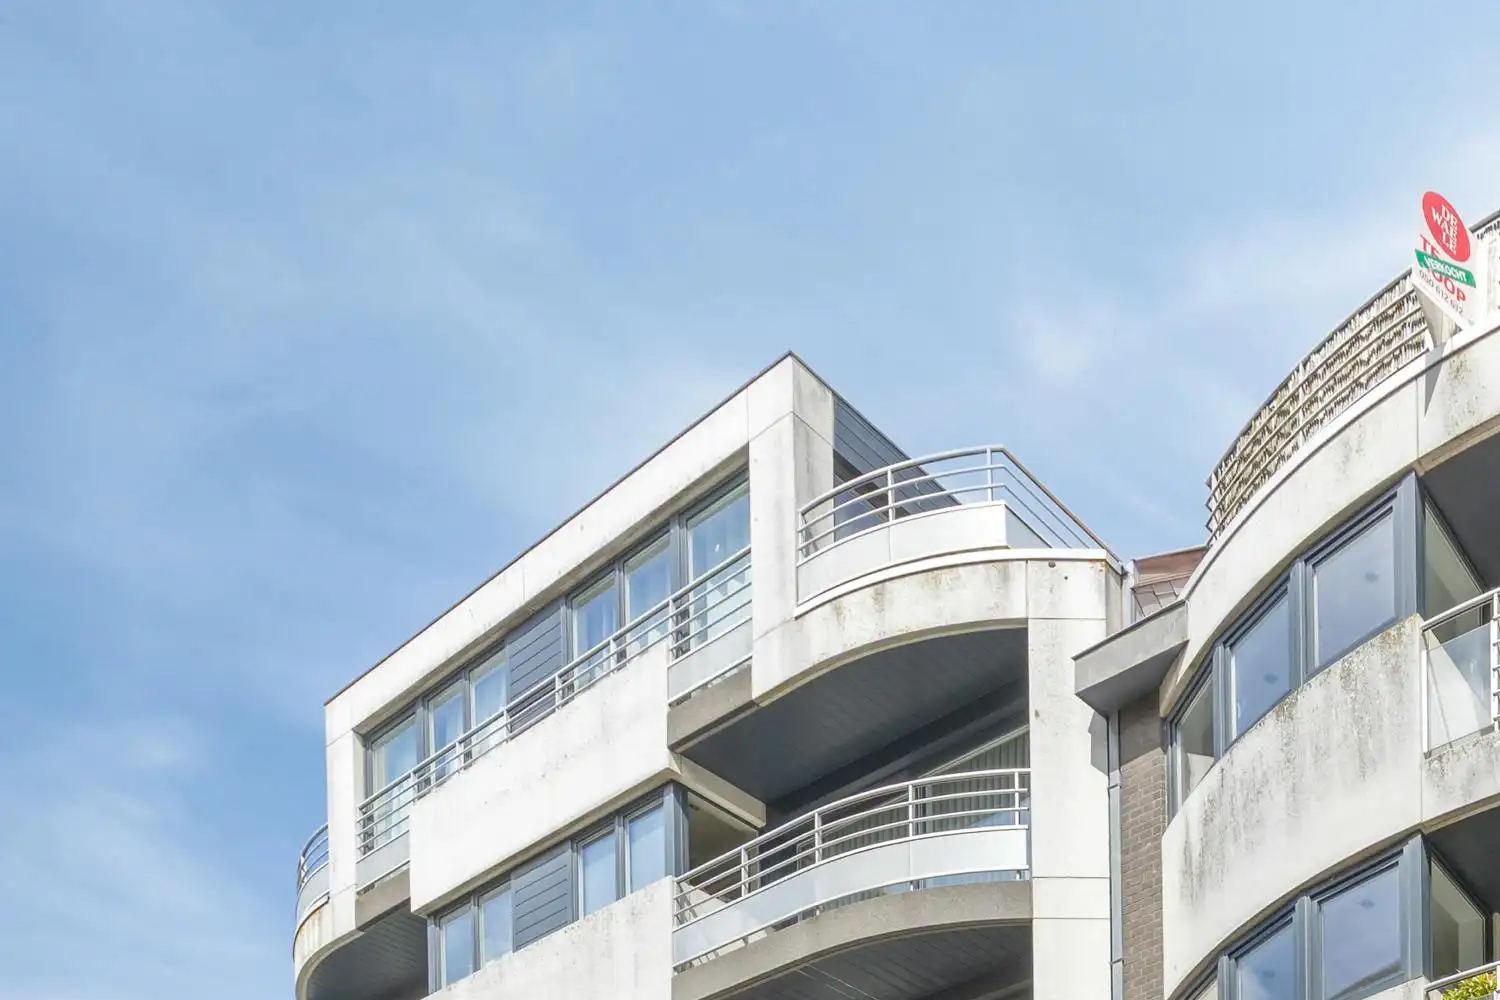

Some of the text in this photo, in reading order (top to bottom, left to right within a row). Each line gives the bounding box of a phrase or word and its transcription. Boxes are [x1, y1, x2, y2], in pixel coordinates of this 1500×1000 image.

[1431, 207, 1457, 239] WAE
[1441, 204, 1457, 226] DE
[1442, 231, 1457, 255] LE
[1423, 254, 1467, 283] VERKOCHT
[1428, 268, 1466, 301] OOP
